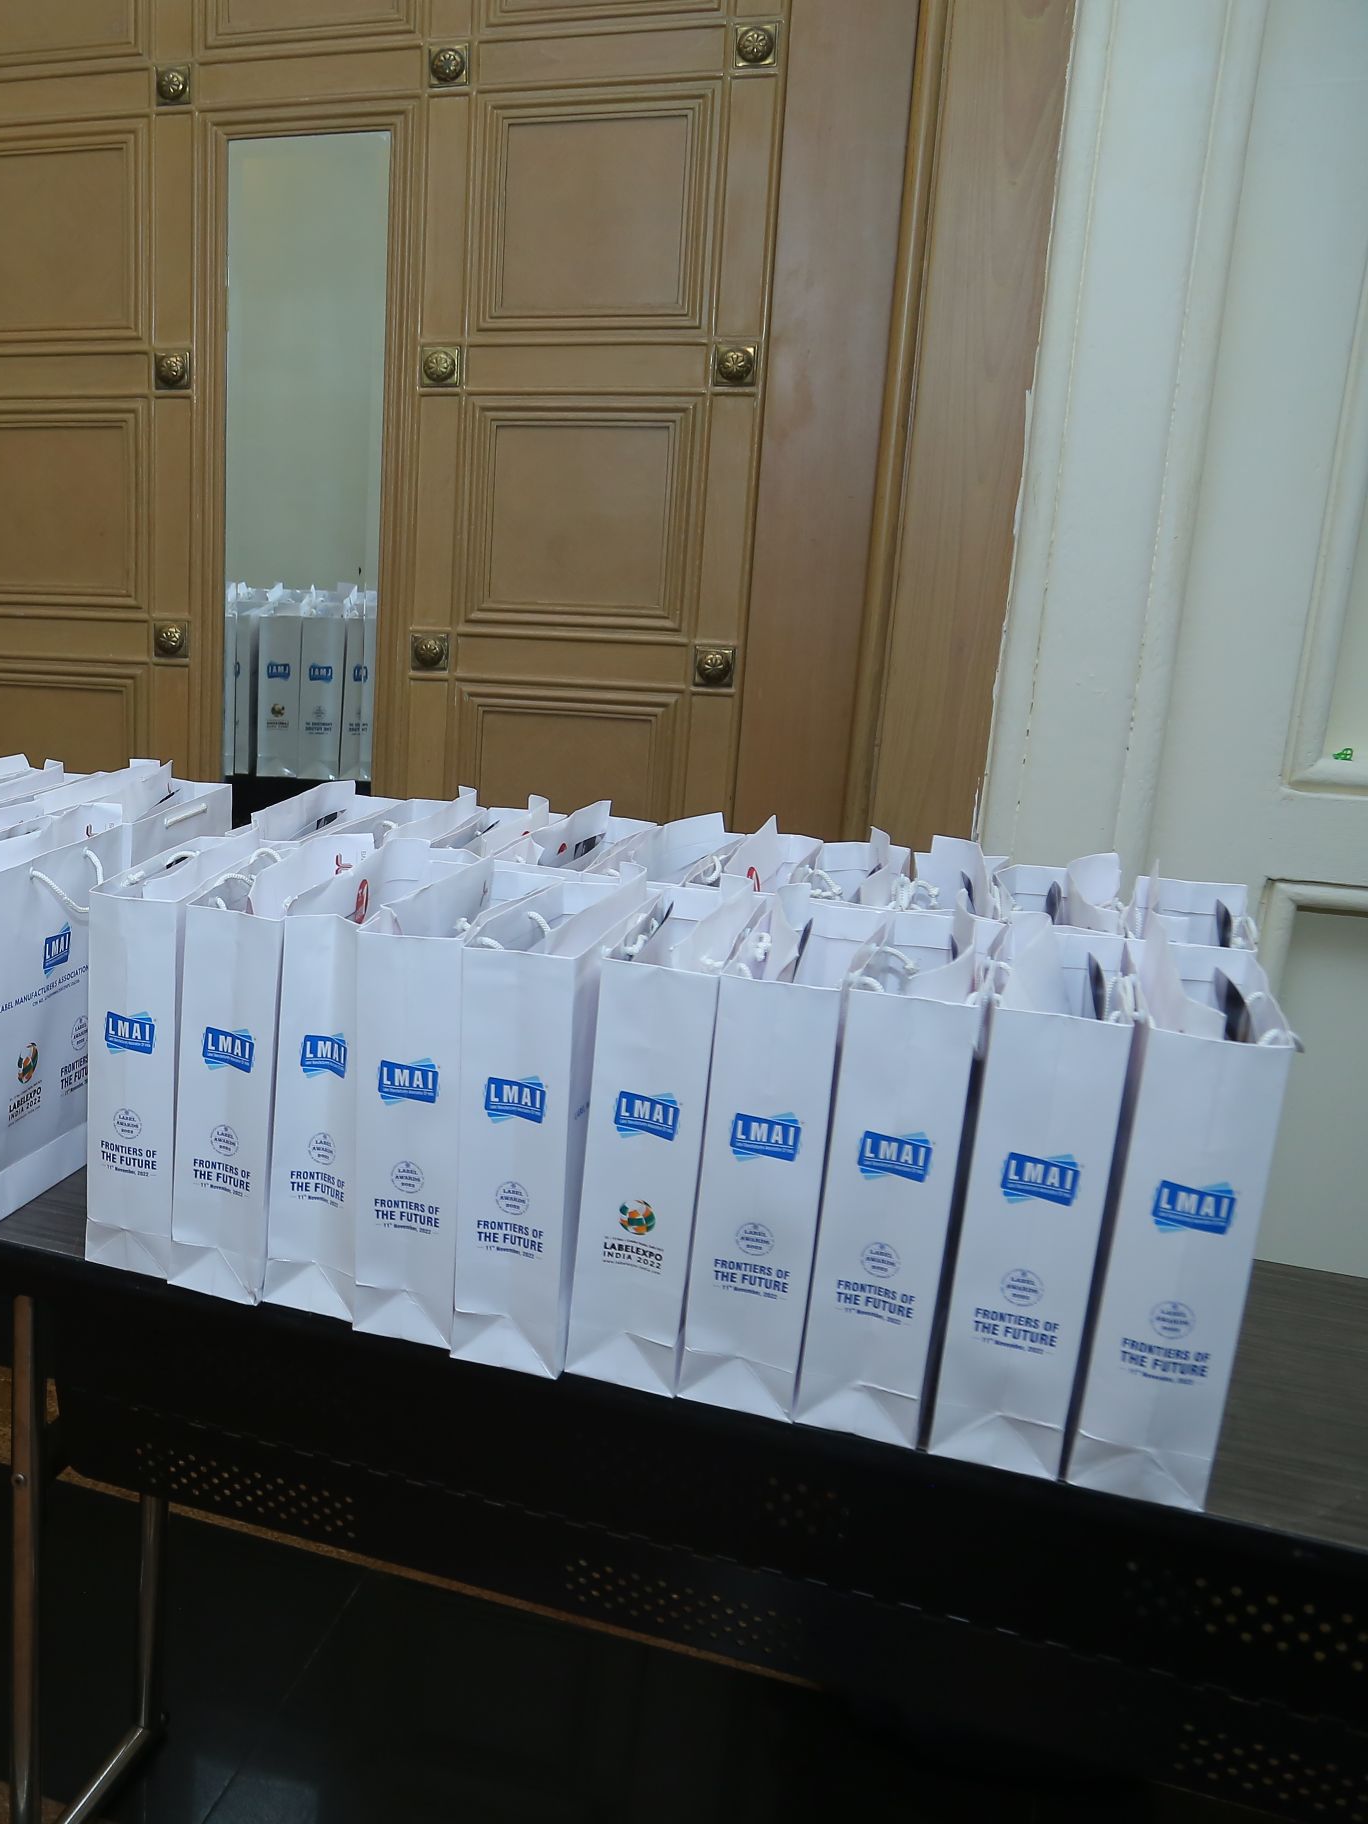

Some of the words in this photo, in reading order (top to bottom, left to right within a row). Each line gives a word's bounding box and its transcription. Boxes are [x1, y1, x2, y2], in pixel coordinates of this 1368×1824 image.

[46, 934, 69, 959] LMAI
[15, 980, 57, 1006] MANUFACTURERS
[109, 1018, 149, 1040] LMAI
[207, 1033, 250, 1058] LMAI
[306, 1041, 344, 1063] LMAI
[61, 1074, 72, 1089] THE
[74, 1066, 88, 1083] FUTU
[383, 1067, 432, 1089] LMAI
[9, 1087, 41, 1112] LABELEXPO
[491, 1084, 541, 1108] LMAI
[9, 1106, 24, 1121] INDIA
[26, 1096, 40, 1109] 2022
[620, 1098, 674, 1125] LMAI
[735, 1120, 795, 1145] LMAI
[101, 1140, 142, 1157] FRONTIERS
[146, 1149, 157, 1159] OF
[101, 1151, 116, 1163] THE
[120, 1155, 157, 1170] FUTURE
[864, 1138, 926, 1166] LMAI
[193, 1159, 239, 1176] FRONTIERS
[241, 1169, 250, 1180] OF
[193, 1169, 212, 1181] THE
[216, 1172, 250, 1191] FUTURE
[291, 1171, 335, 1187] FRONTIERS
[337, 1179, 345, 1190] OF
[1008, 1160, 1073, 1190] LMAI
[291, 1182, 310, 1193] THE
[314, 1183, 344, 1203] FUTURE
[1161, 1187, 1230, 1218] LMAI
[375, 1199, 425, 1214] FRONTIERS
[428, 1205, 439, 1215] OF
[375, 1210, 395, 1221] THE
[400, 1211, 439, 1228] FUTURE
[477, 1220, 529, 1236] FRONTIERS
[532, 1229, 543, 1240] OF
[477, 1231, 499, 1243] THE
[503, 1234, 543, 1253] FUTURE
[604, 1242, 663, 1261] LABELEXPO
[603, 1251, 632, 1261] INDIA
[637, 1257, 662, 1269] 2022
[714, 1259, 772, 1277] FRONTIERS
[776, 1269, 790, 1280] OF
[714, 1270, 737, 1283] THE
[742, 1273, 788, 1293] FUTURE
[837, 1279, 897, 1300] FRONTIERS
[901, 1294, 915, 1305] OF
[836, 1292, 860, 1306] THE
[864, 1295, 913, 1319] FUTURE
[975, 1308, 1040, 1330] FRONTIERS
[1043, 1321, 1060, 1333] OF
[975, 1320, 999, 1336] THE
[1003, 1325, 1057, 1347] FUTURE
[1122, 1337, 1190, 1360] FRONTIERS
[1194, 1351, 1211, 1363] OF
[1121, 1350, 1147, 1367] THE
[1151, 1358, 1208, 1377] FUTURE
